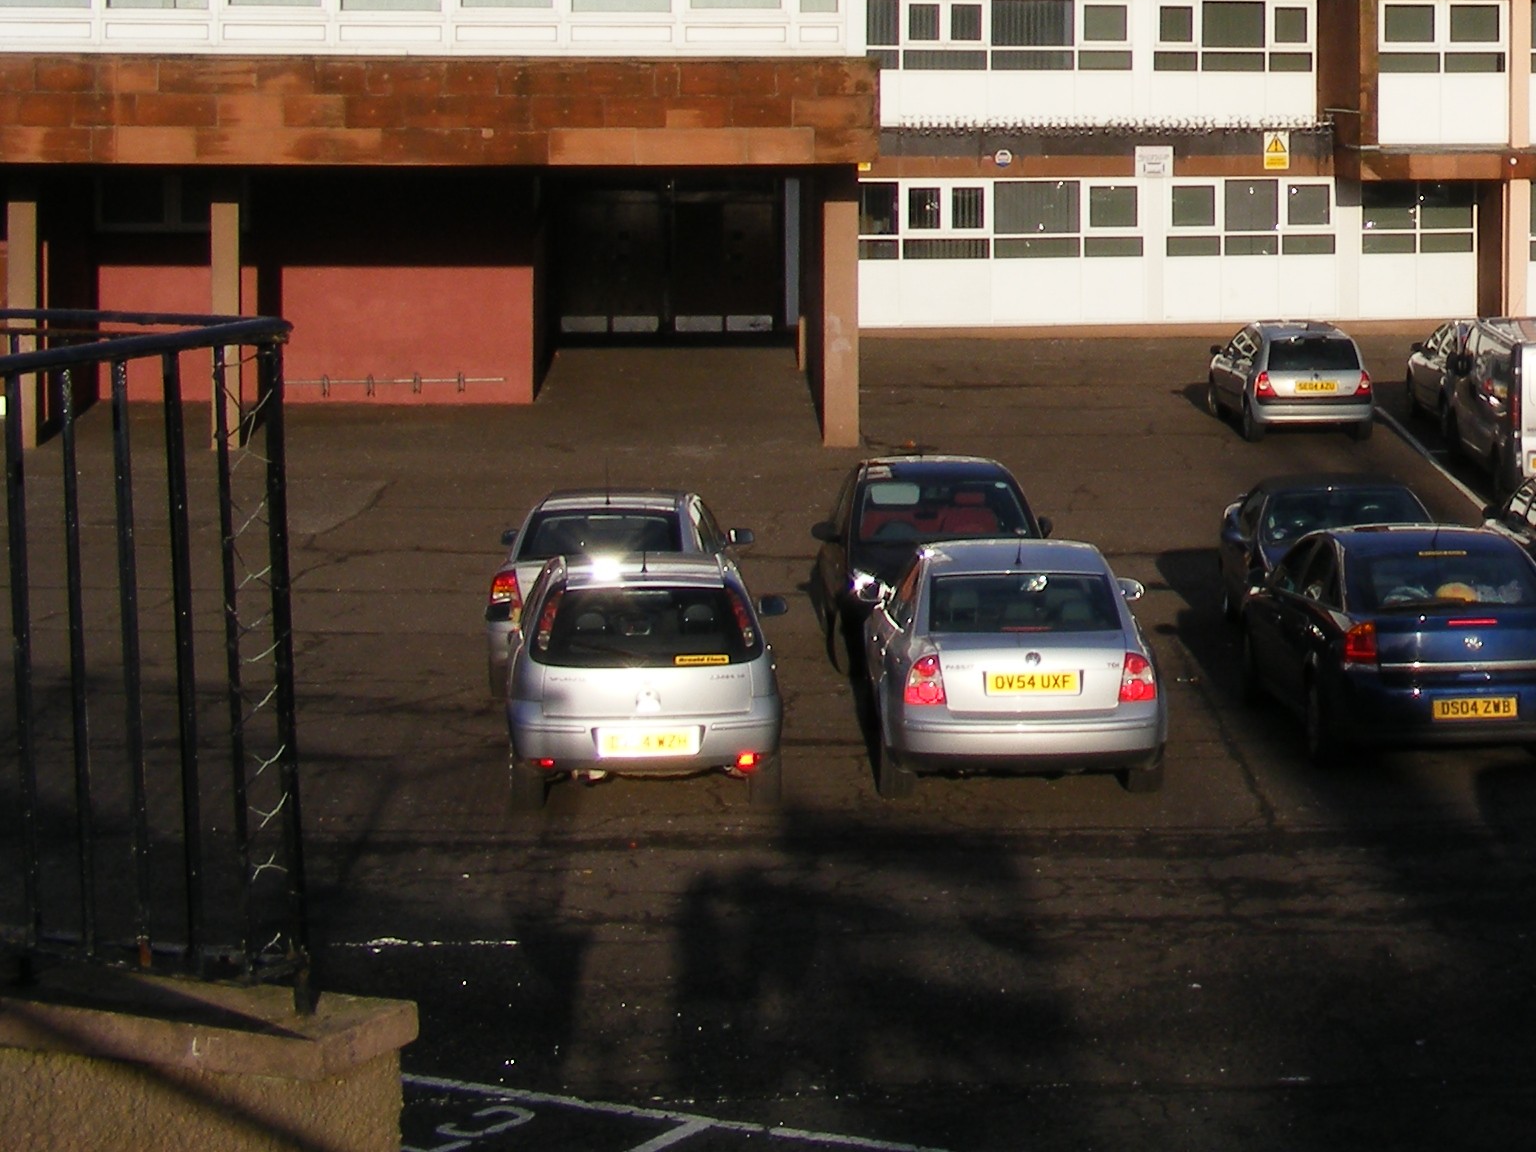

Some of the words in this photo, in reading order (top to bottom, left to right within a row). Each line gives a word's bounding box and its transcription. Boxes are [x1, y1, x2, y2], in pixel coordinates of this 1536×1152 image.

[995, 675, 1036, 690] OV54
[1041, 674, 1072, 689] UXF
[1441, 700, 1478, 716] DS04
[1482, 699, 1512, 715] ZWB
